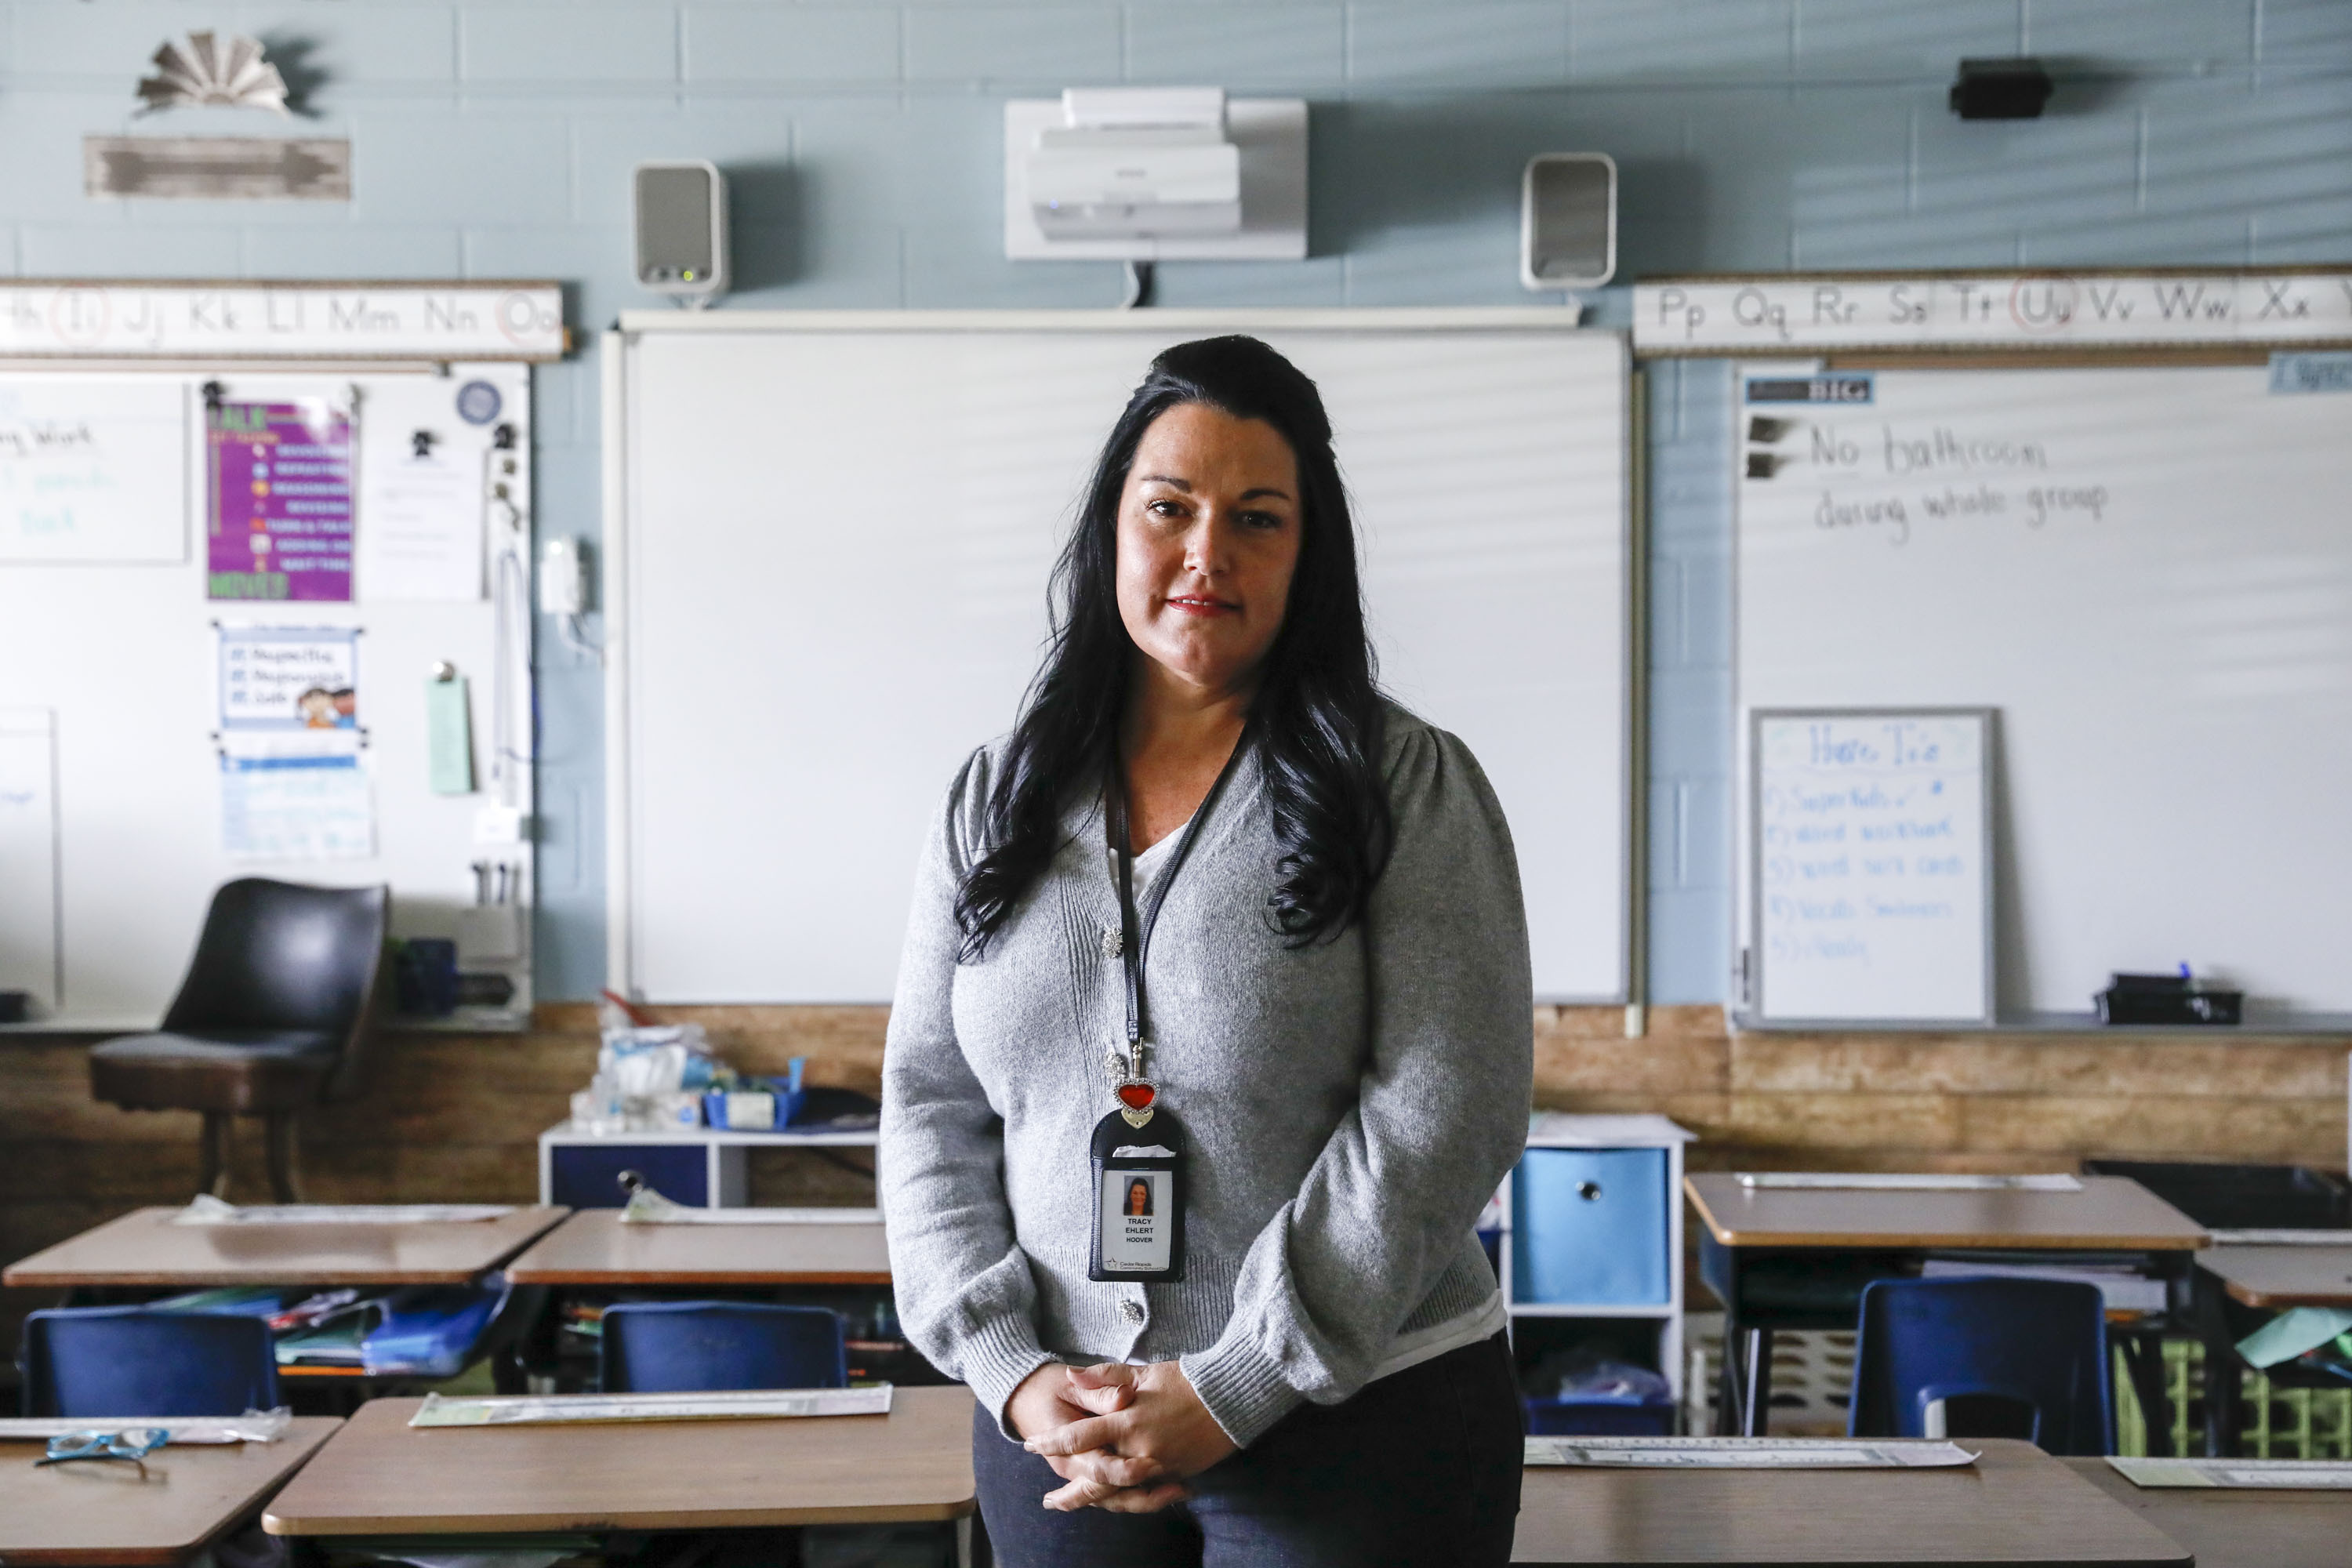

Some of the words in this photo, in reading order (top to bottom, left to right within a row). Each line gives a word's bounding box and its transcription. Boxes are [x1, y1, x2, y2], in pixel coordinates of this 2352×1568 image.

[123, 291, 165, 347] Jj
[189, 291, 239, 333] Kk
[328, 291, 401, 333] Mm
[424, 291, 479, 333] Nn
[503, 291, 559, 334] Oo
[1658, 286, 1706, 340] Pp
[1733, 286, 1792, 342] Qq
[1813, 284, 1860, 325] Rr
[1889, 283, 1927, 325] Ss
[1952, 282, 1991, 322] Tt
[2021, 281, 2071, 324] Uu
[2088, 281, 2136, 322] Vv
[2153, 281, 2231, 321] Ww
[2258, 279, 2309, 320] Xx
[1811, 423, 1860, 466] No
[1882, 423, 2048, 474] bathroom
[2024, 483, 2110, 531] group
